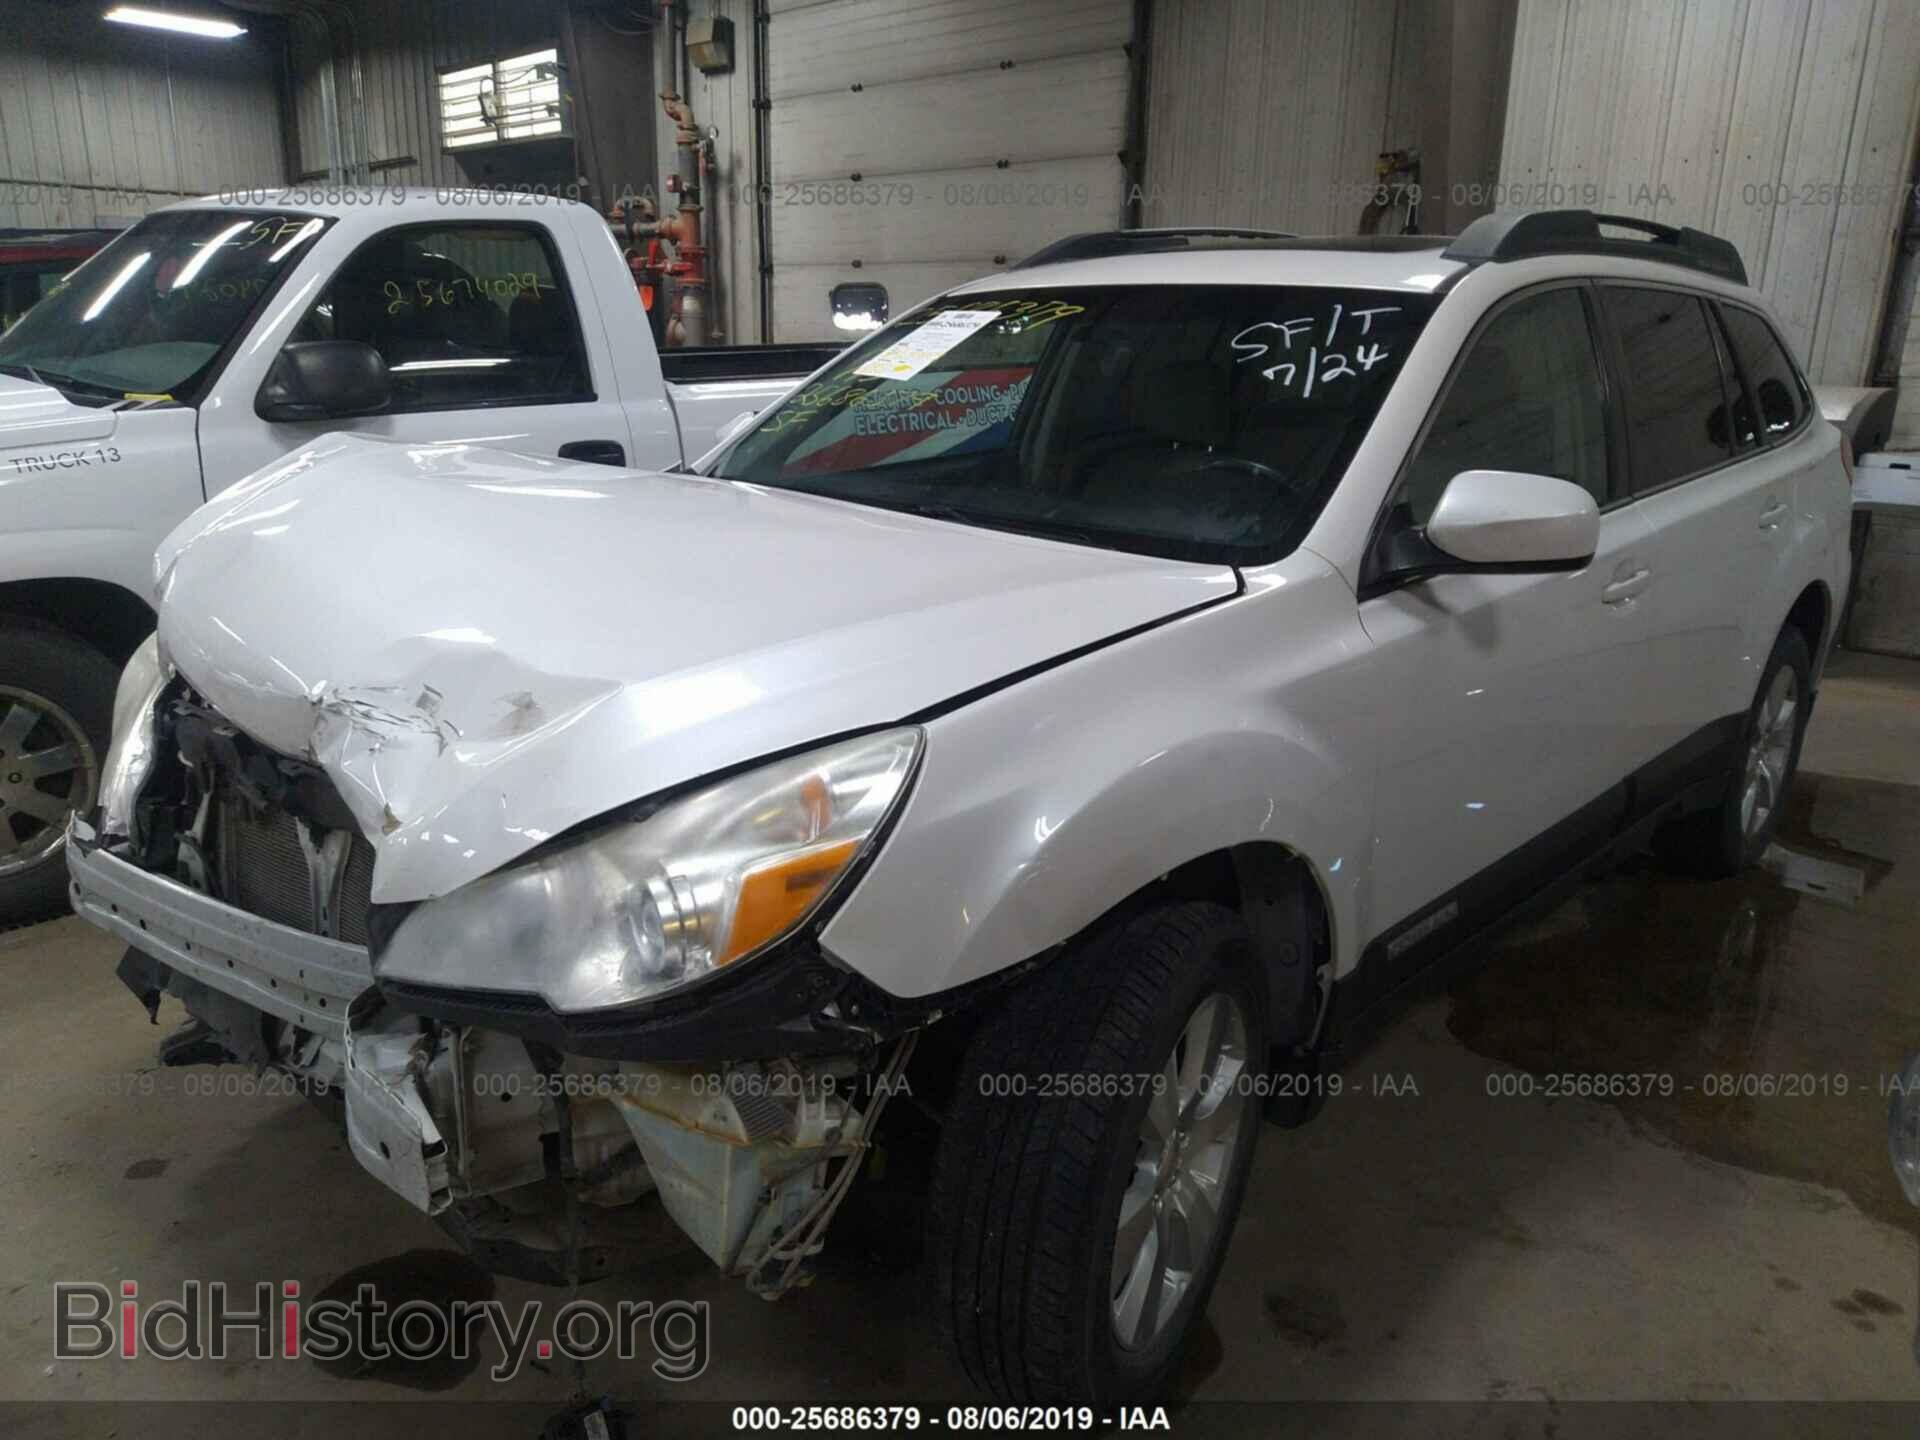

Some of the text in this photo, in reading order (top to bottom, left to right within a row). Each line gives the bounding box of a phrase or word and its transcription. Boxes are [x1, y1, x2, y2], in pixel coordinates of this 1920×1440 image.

[935, 383, 1001, 406] COOLING
[855, 408, 955, 436] ELECTRICAL
[8, 447, 121, 474] TRUCK 13
